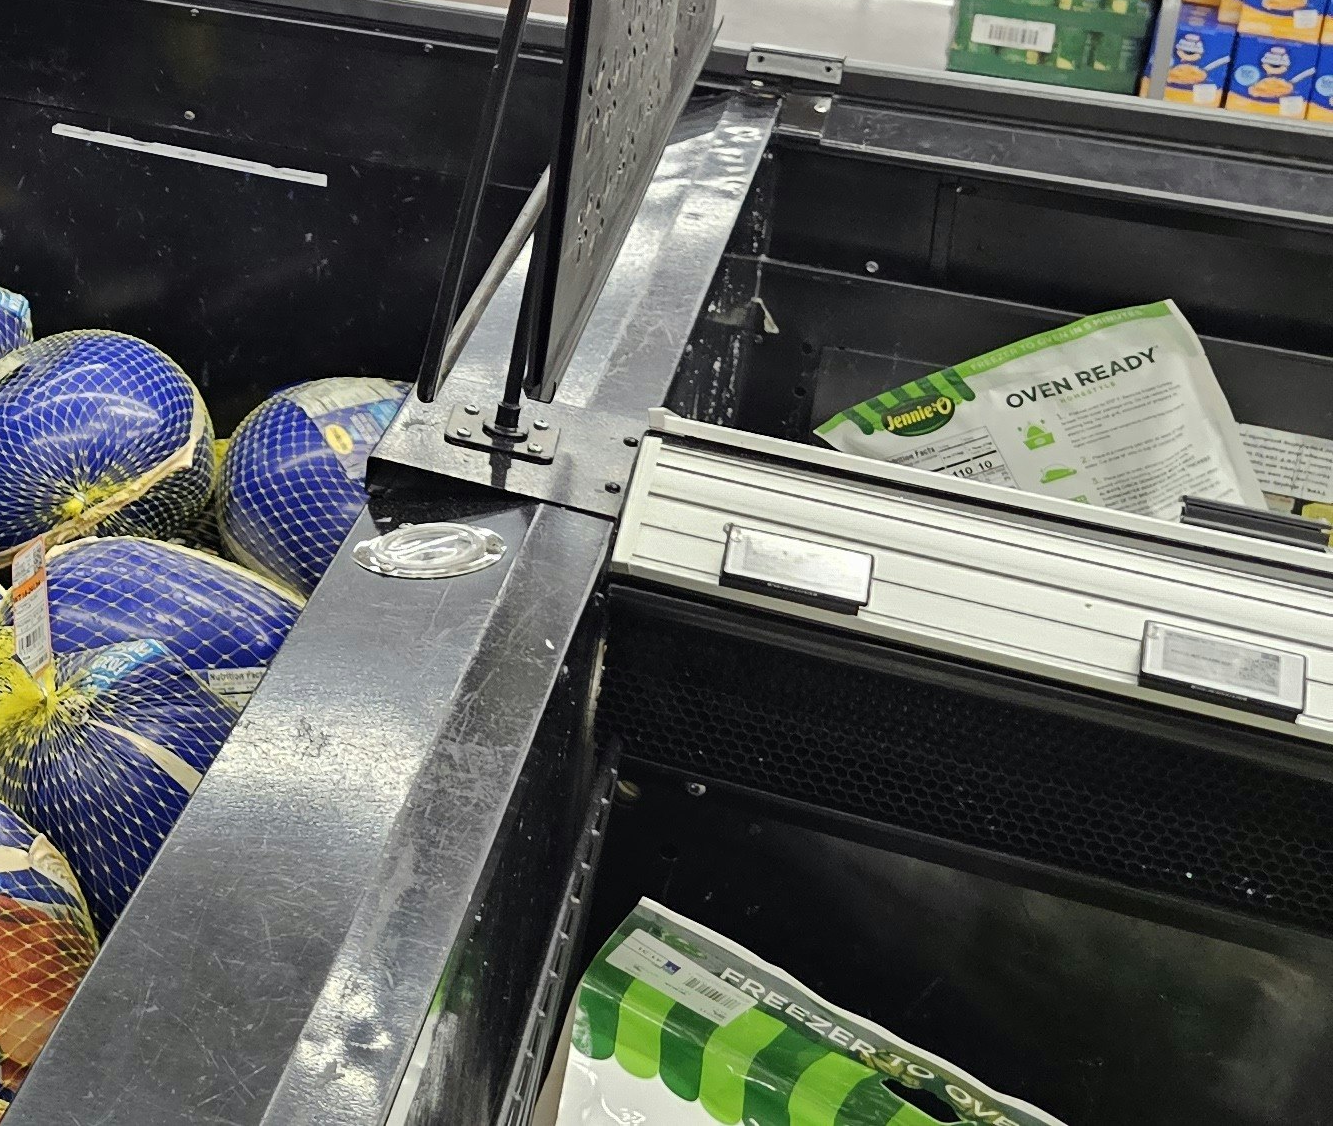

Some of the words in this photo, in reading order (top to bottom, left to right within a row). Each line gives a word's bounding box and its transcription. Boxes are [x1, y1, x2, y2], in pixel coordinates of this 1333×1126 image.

[970, 348, 1018, 372] FREEZER
[1021, 340, 1036, 353] TO
[1036, 331, 1069, 347] OVEN
[1069, 325, 1083, 338] IN
[1092, 309, 1144, 327] MINUTES
[1006, 377, 1073, 408] OVEN
[1075, 347, 1157, 387] READY
[978, 460, 993, 472] 10
[719, 966, 879, 1061] FREEZER
[883, 1051, 936, 1080] TO
